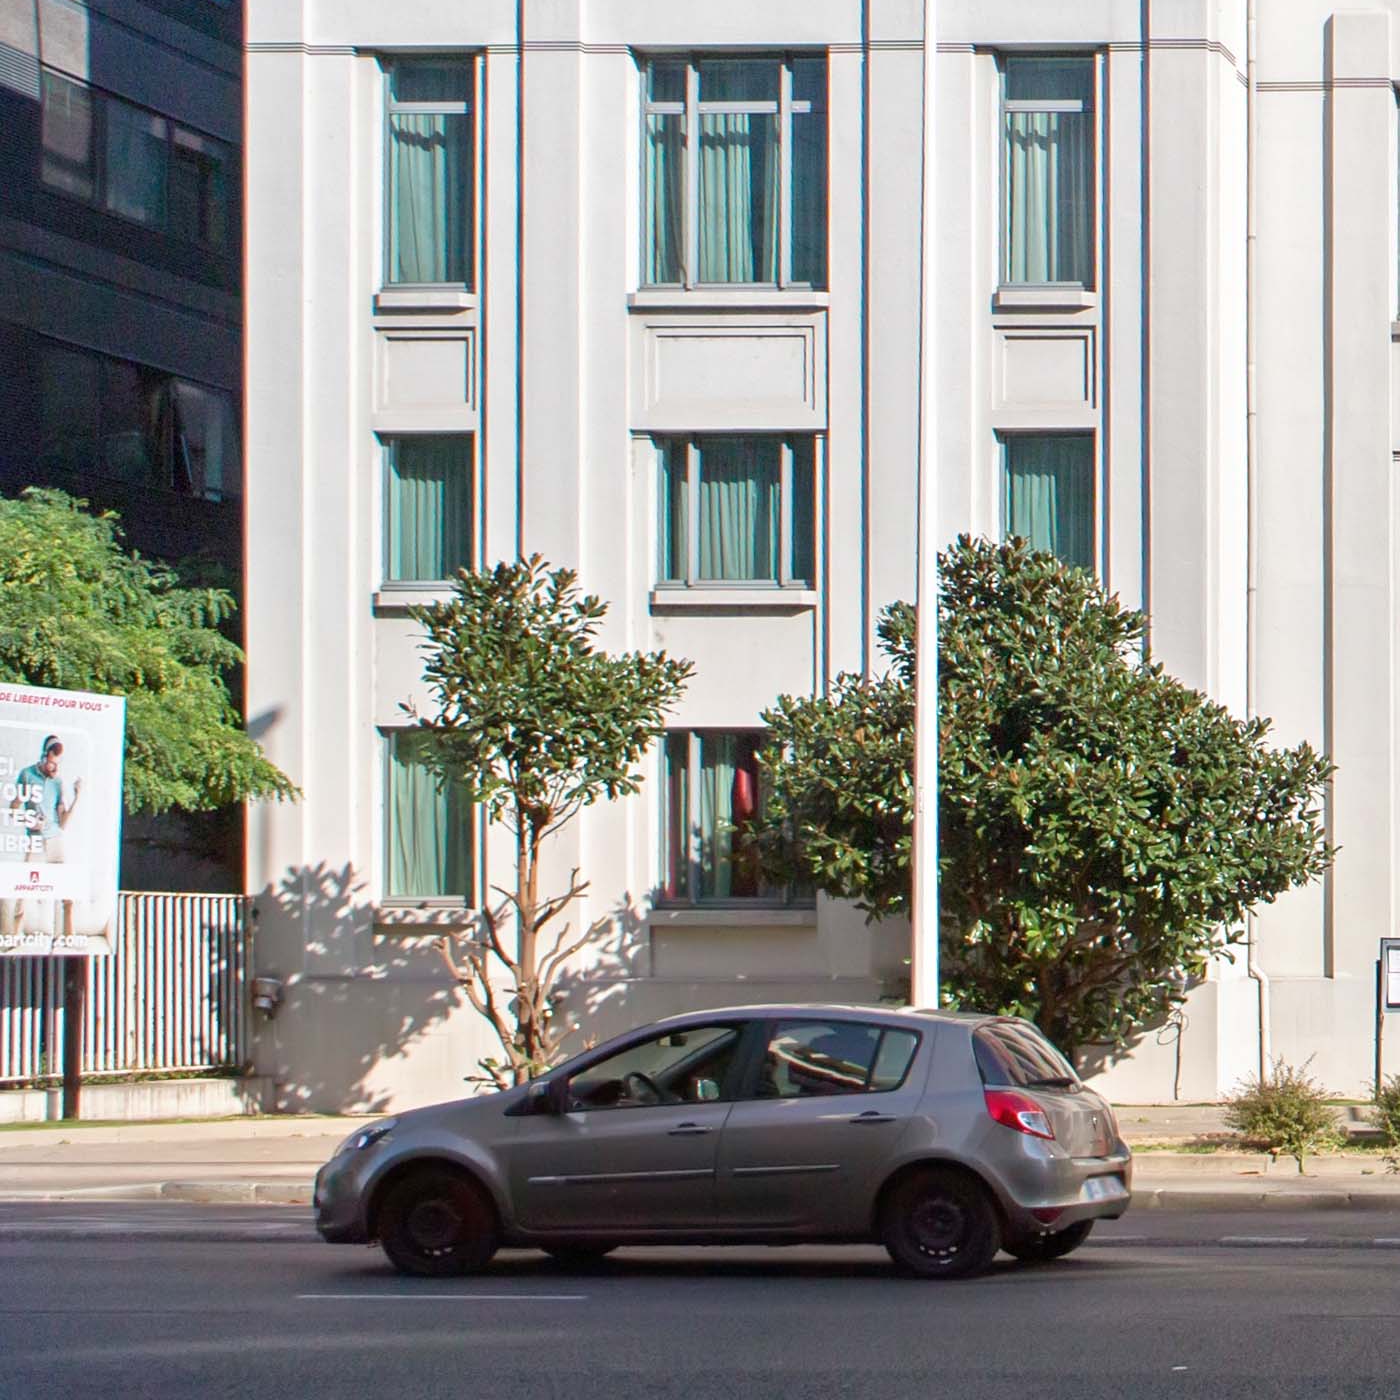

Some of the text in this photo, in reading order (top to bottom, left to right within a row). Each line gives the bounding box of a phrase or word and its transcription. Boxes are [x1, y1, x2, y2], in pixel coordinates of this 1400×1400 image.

[52, 698, 76, 708] POUR
[80, 701, 102, 711] VOUS
[0, 783, 43, 804] OUS
